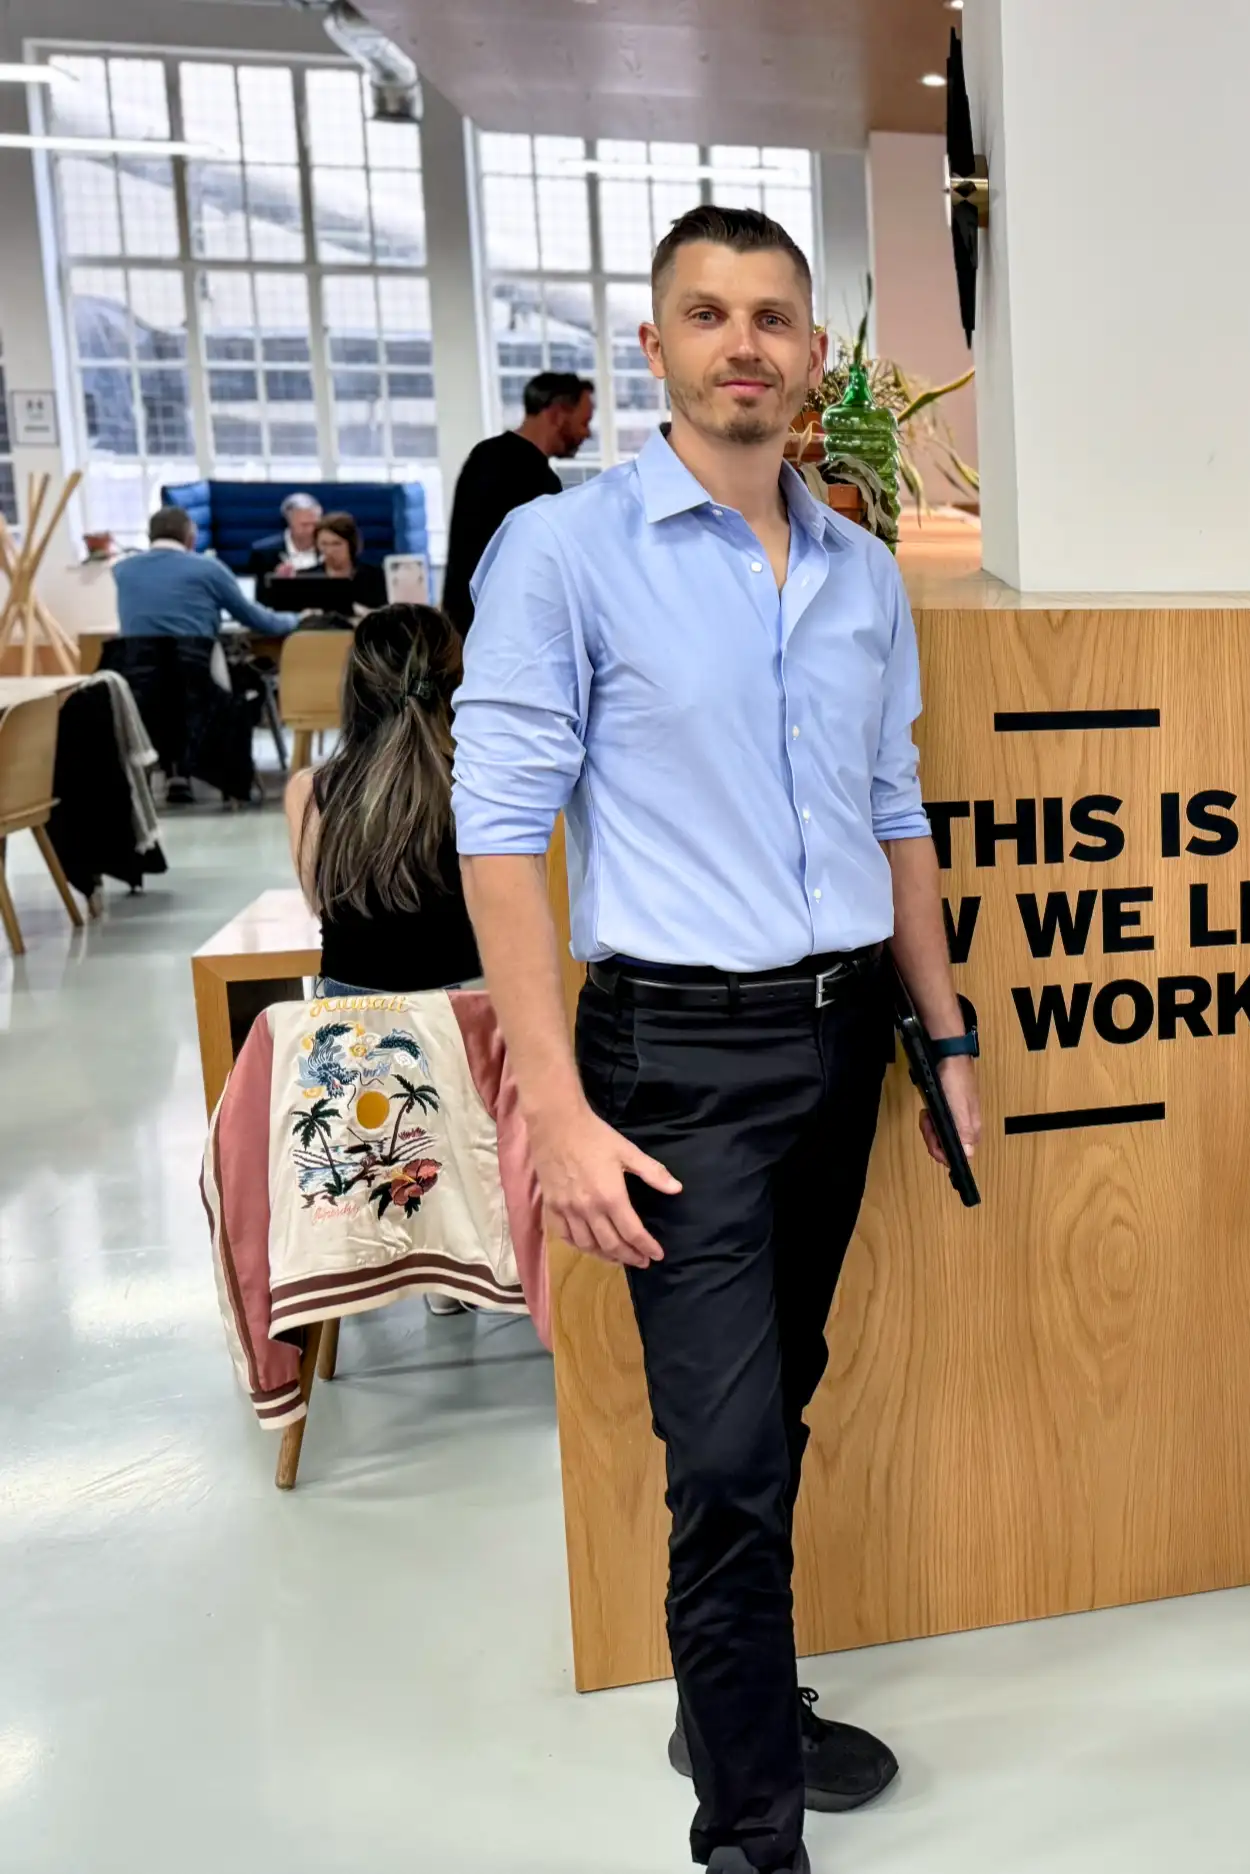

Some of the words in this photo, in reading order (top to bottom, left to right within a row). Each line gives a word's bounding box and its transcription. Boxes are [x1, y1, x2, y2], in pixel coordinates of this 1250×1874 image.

[924, 794, 1126, 870] THIS
[1160, 789, 1240, 859] IS
[1016, 886, 1155, 959] WE
